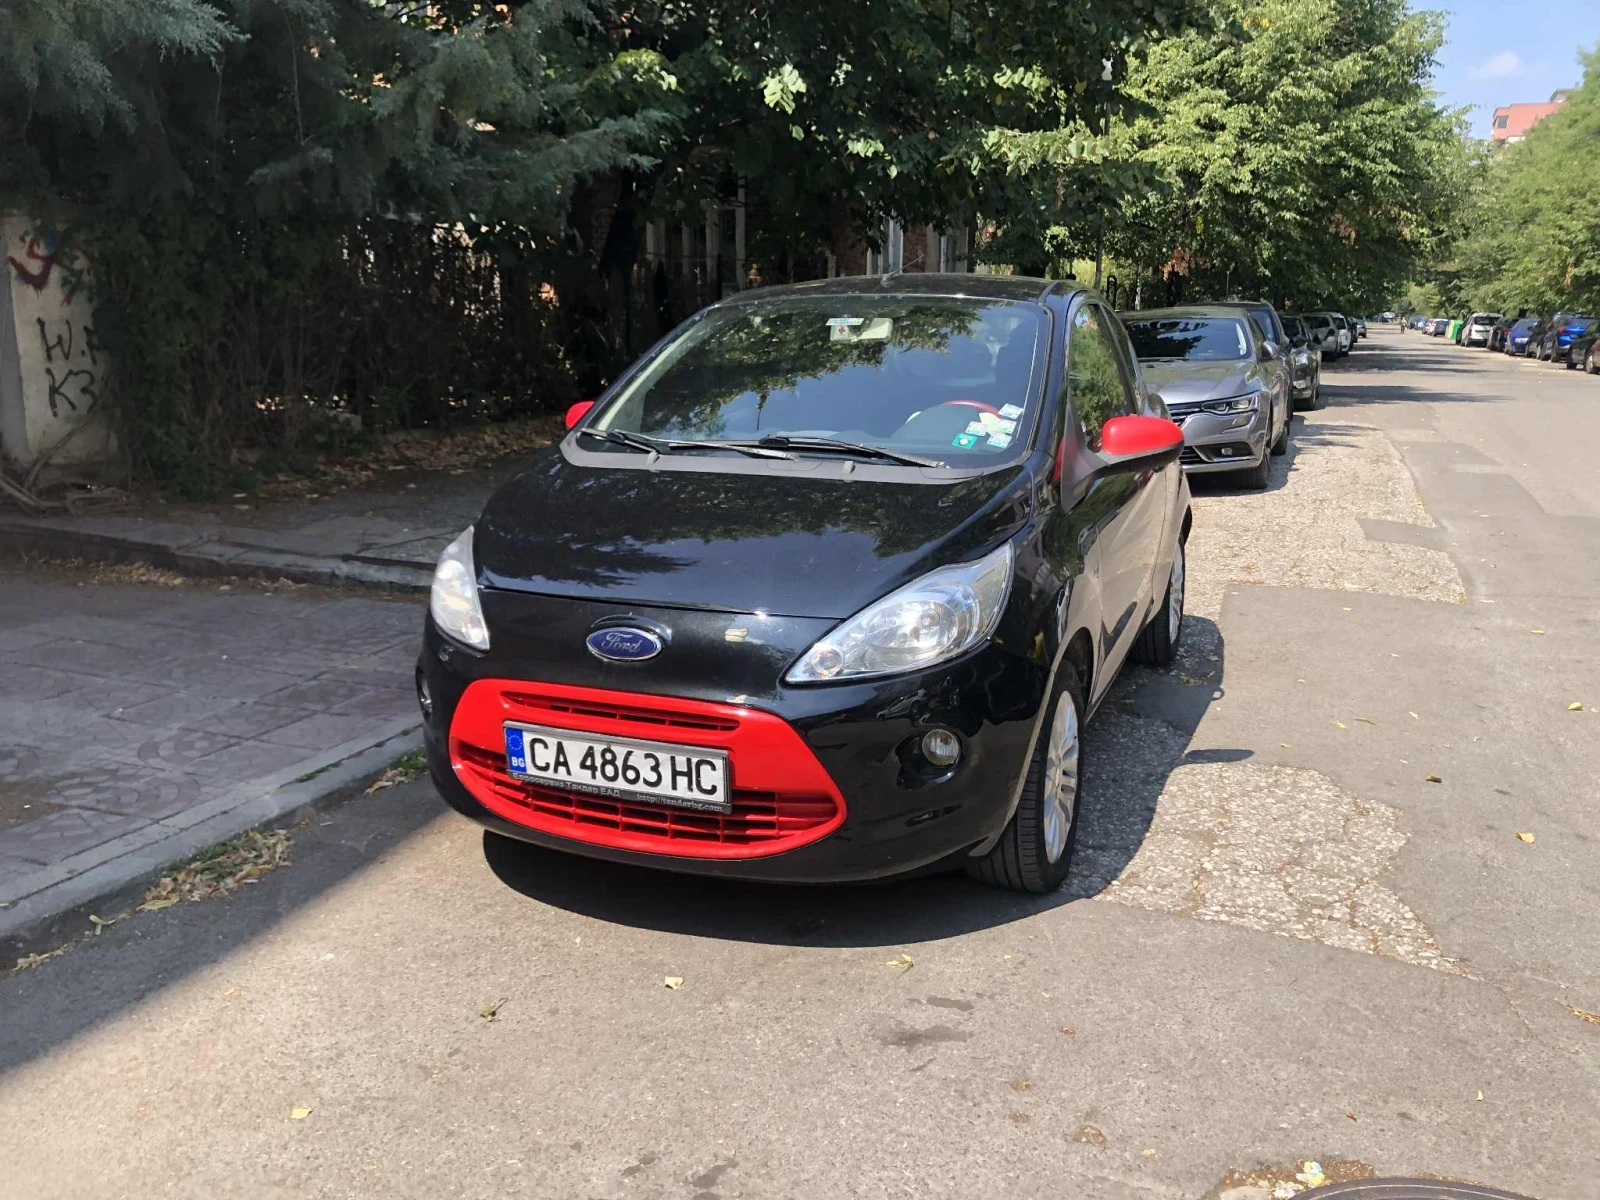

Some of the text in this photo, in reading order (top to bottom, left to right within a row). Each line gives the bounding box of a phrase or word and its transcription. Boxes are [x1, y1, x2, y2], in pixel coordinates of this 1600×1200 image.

[601, 632, 643, 653] Ford
[511, 756, 526, 768] BG
[529, 737, 718, 796] CA 4863 HC
